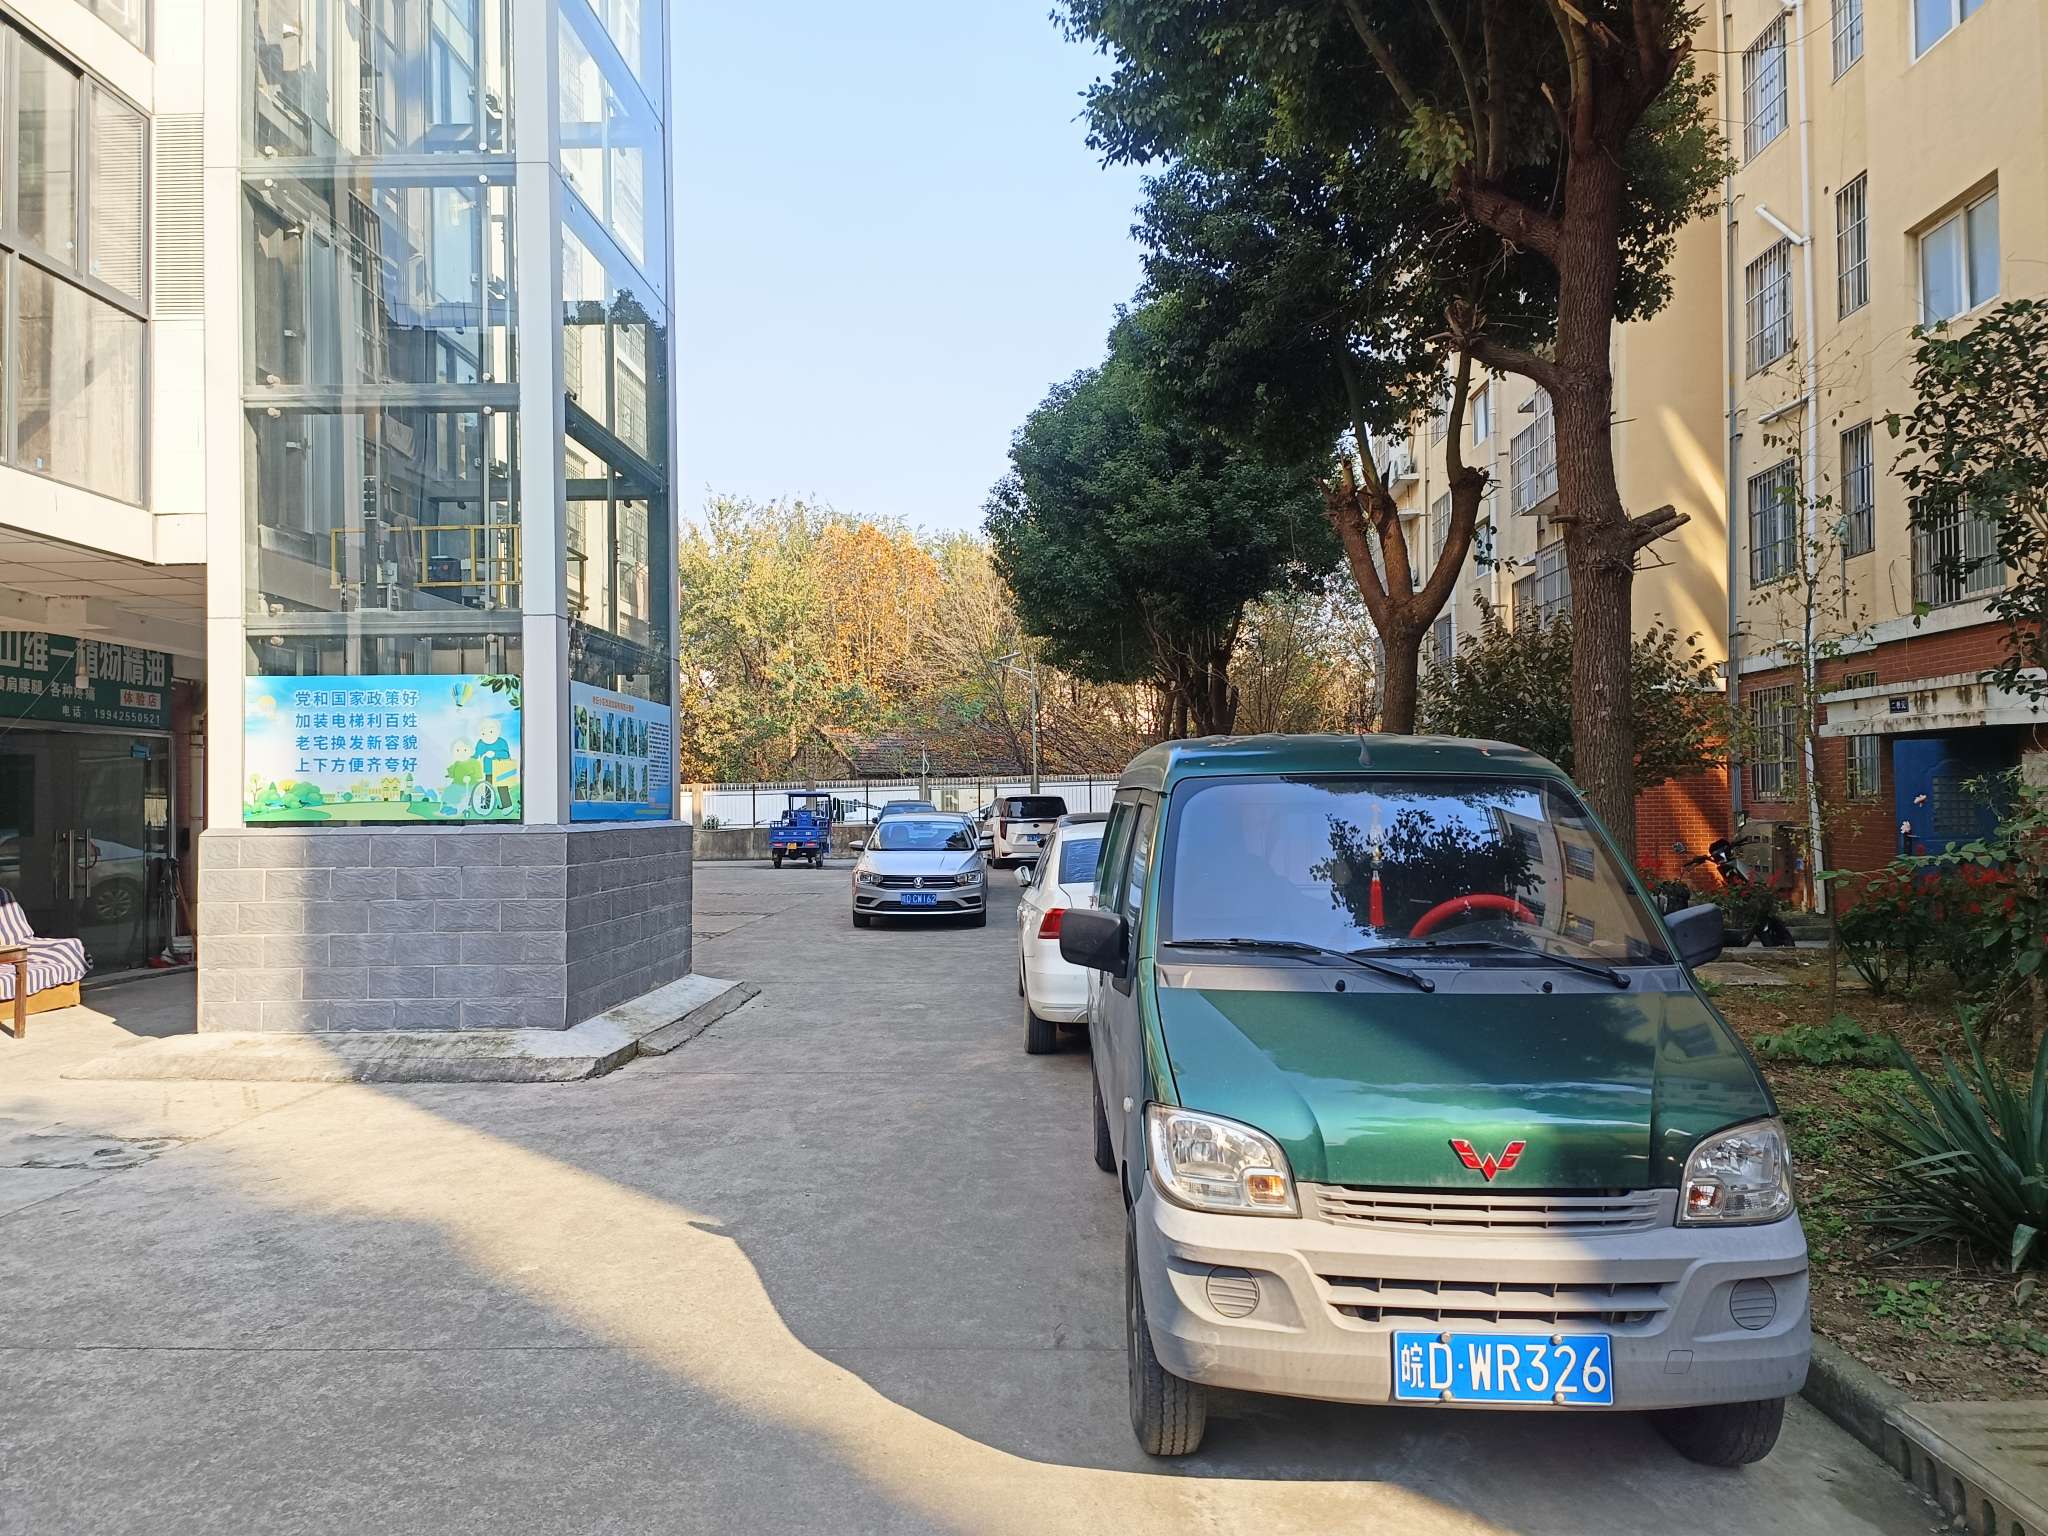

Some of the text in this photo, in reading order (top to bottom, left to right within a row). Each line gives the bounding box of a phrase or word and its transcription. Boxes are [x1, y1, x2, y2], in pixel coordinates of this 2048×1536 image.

[123, 690, 158, 707] 体验店
[295, 690, 418, 707] 党和国家政策好
[295, 712, 418, 729] 加装电梯利百姓
[295, 734, 418, 751] 老宅换发新容貌
[295, 757, 418, 773] 上下方便齐夸好
[1401, 1342, 1607, 1394] 皖D·WR326
